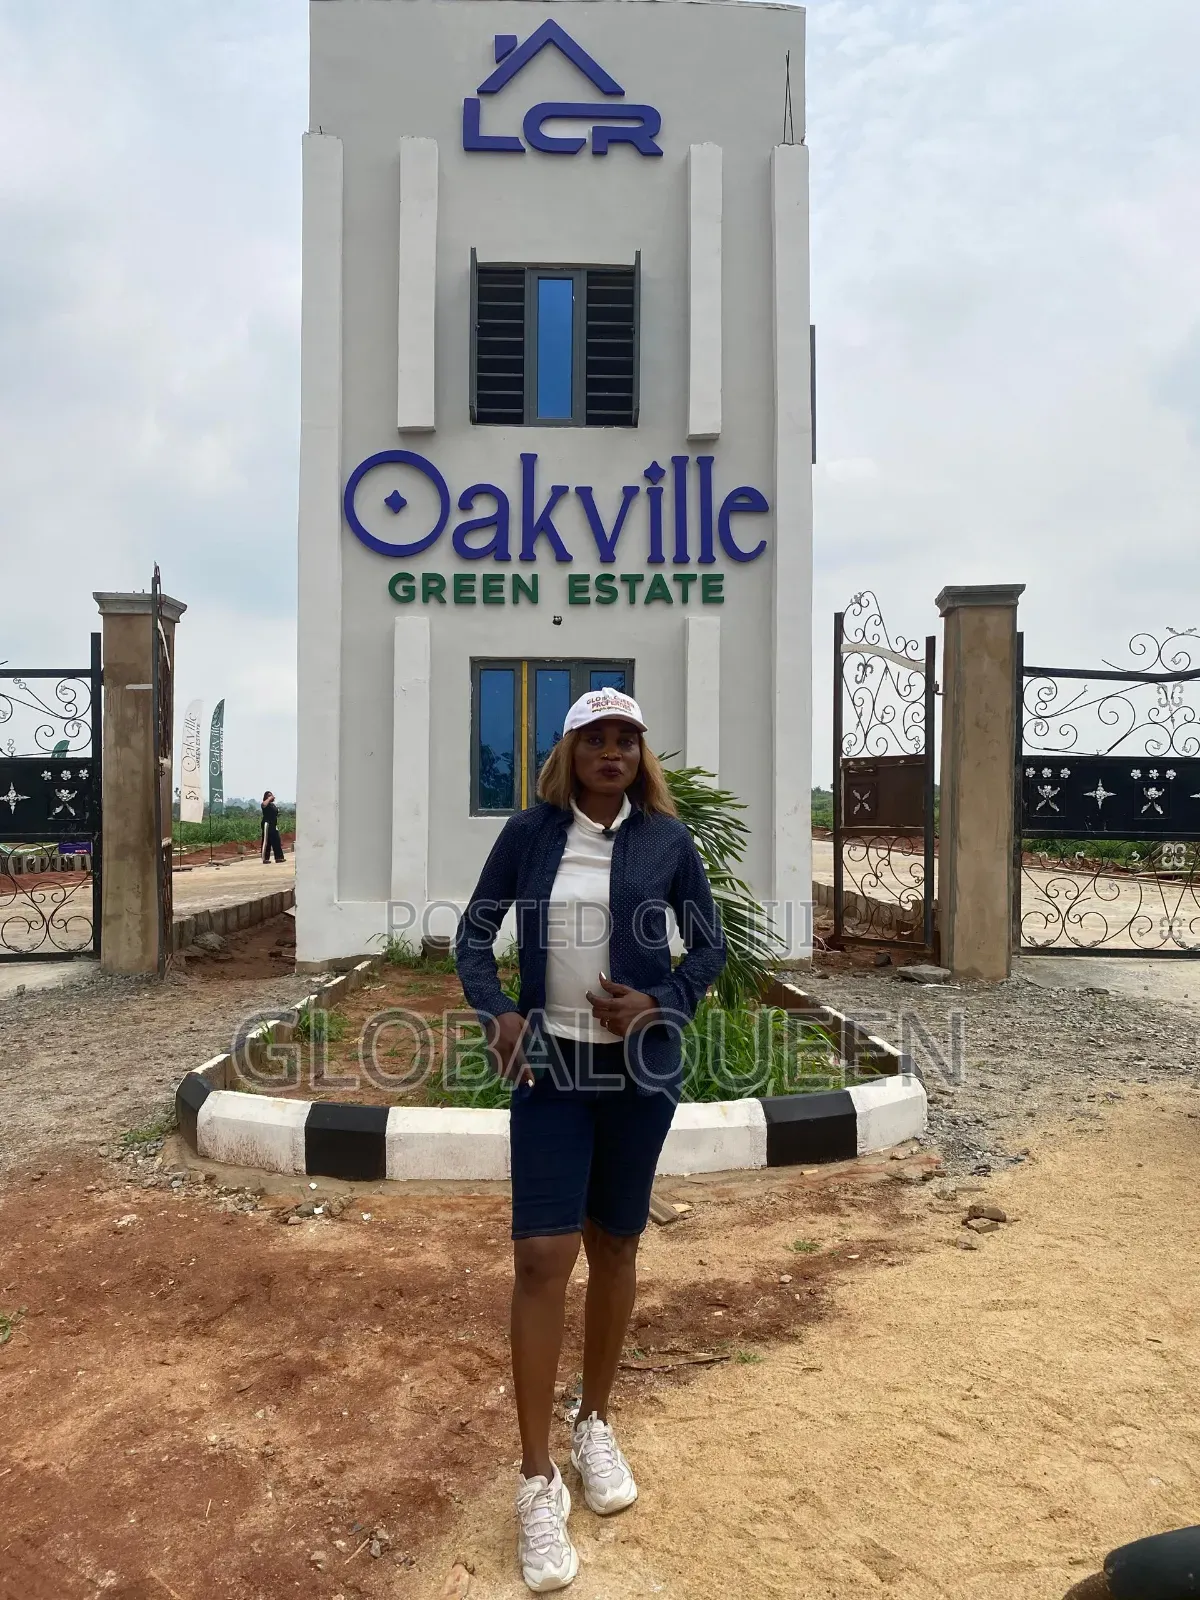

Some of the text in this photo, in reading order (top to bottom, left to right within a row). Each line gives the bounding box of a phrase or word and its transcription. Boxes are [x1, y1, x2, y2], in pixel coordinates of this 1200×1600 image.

[463, 97, 663, 156] LCR
[344, 449, 769, 563] Oakville
[388, 572, 725, 605] GREEN ESTATE
[182, 712, 197, 772] Oakville
[209, 722, 221, 776] Oakville
